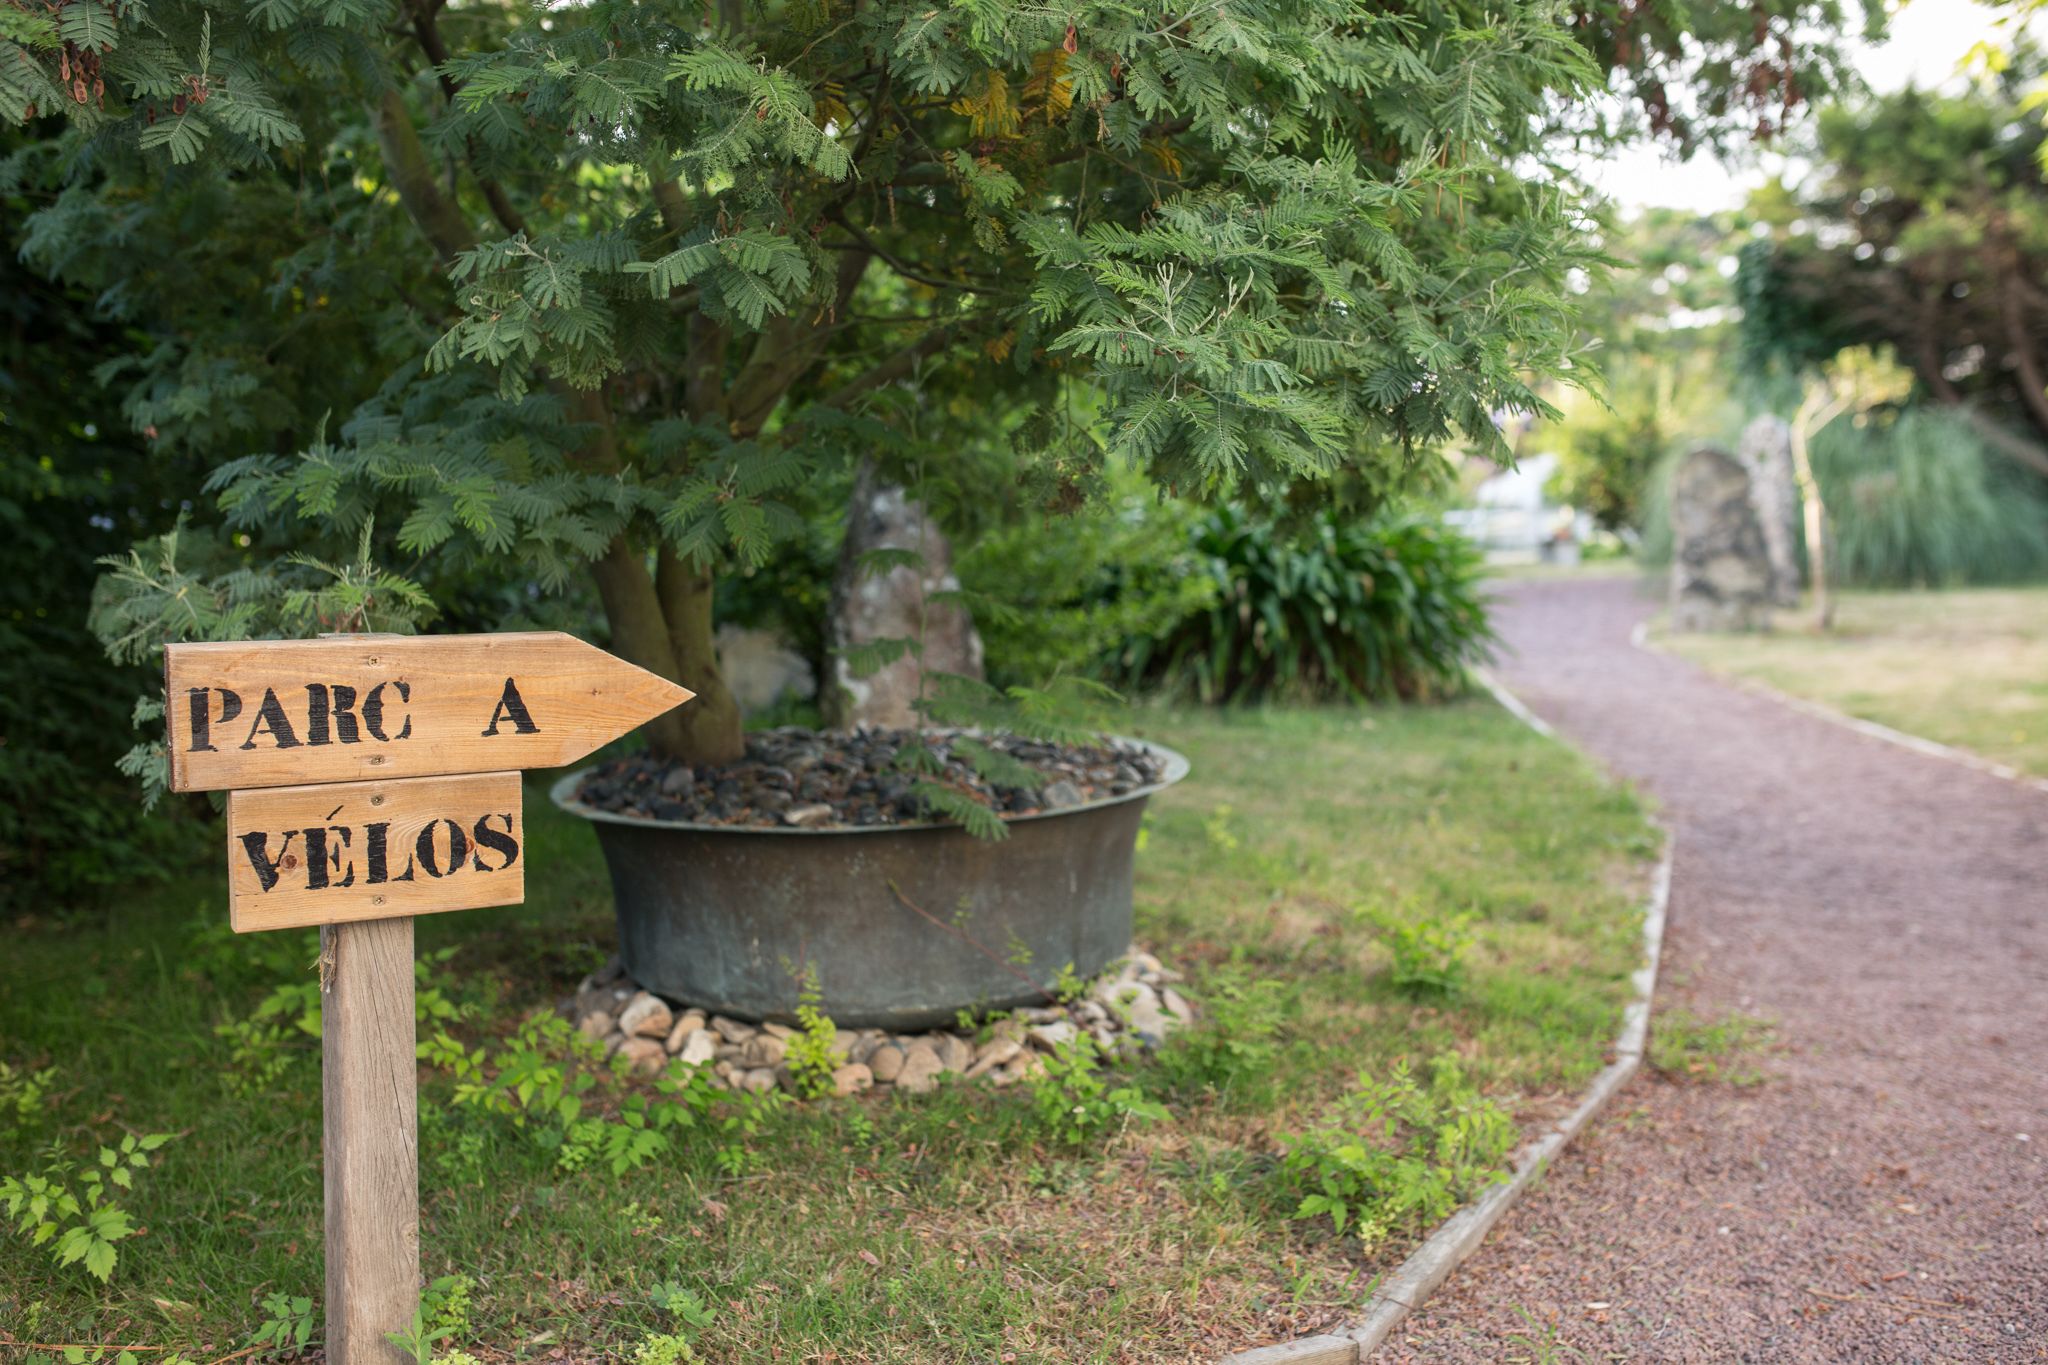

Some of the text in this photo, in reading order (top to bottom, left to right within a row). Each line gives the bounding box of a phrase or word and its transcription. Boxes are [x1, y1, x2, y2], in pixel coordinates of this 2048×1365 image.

[186, 677, 541, 752] PARC A
[236, 805, 520, 893] VÉLOS
